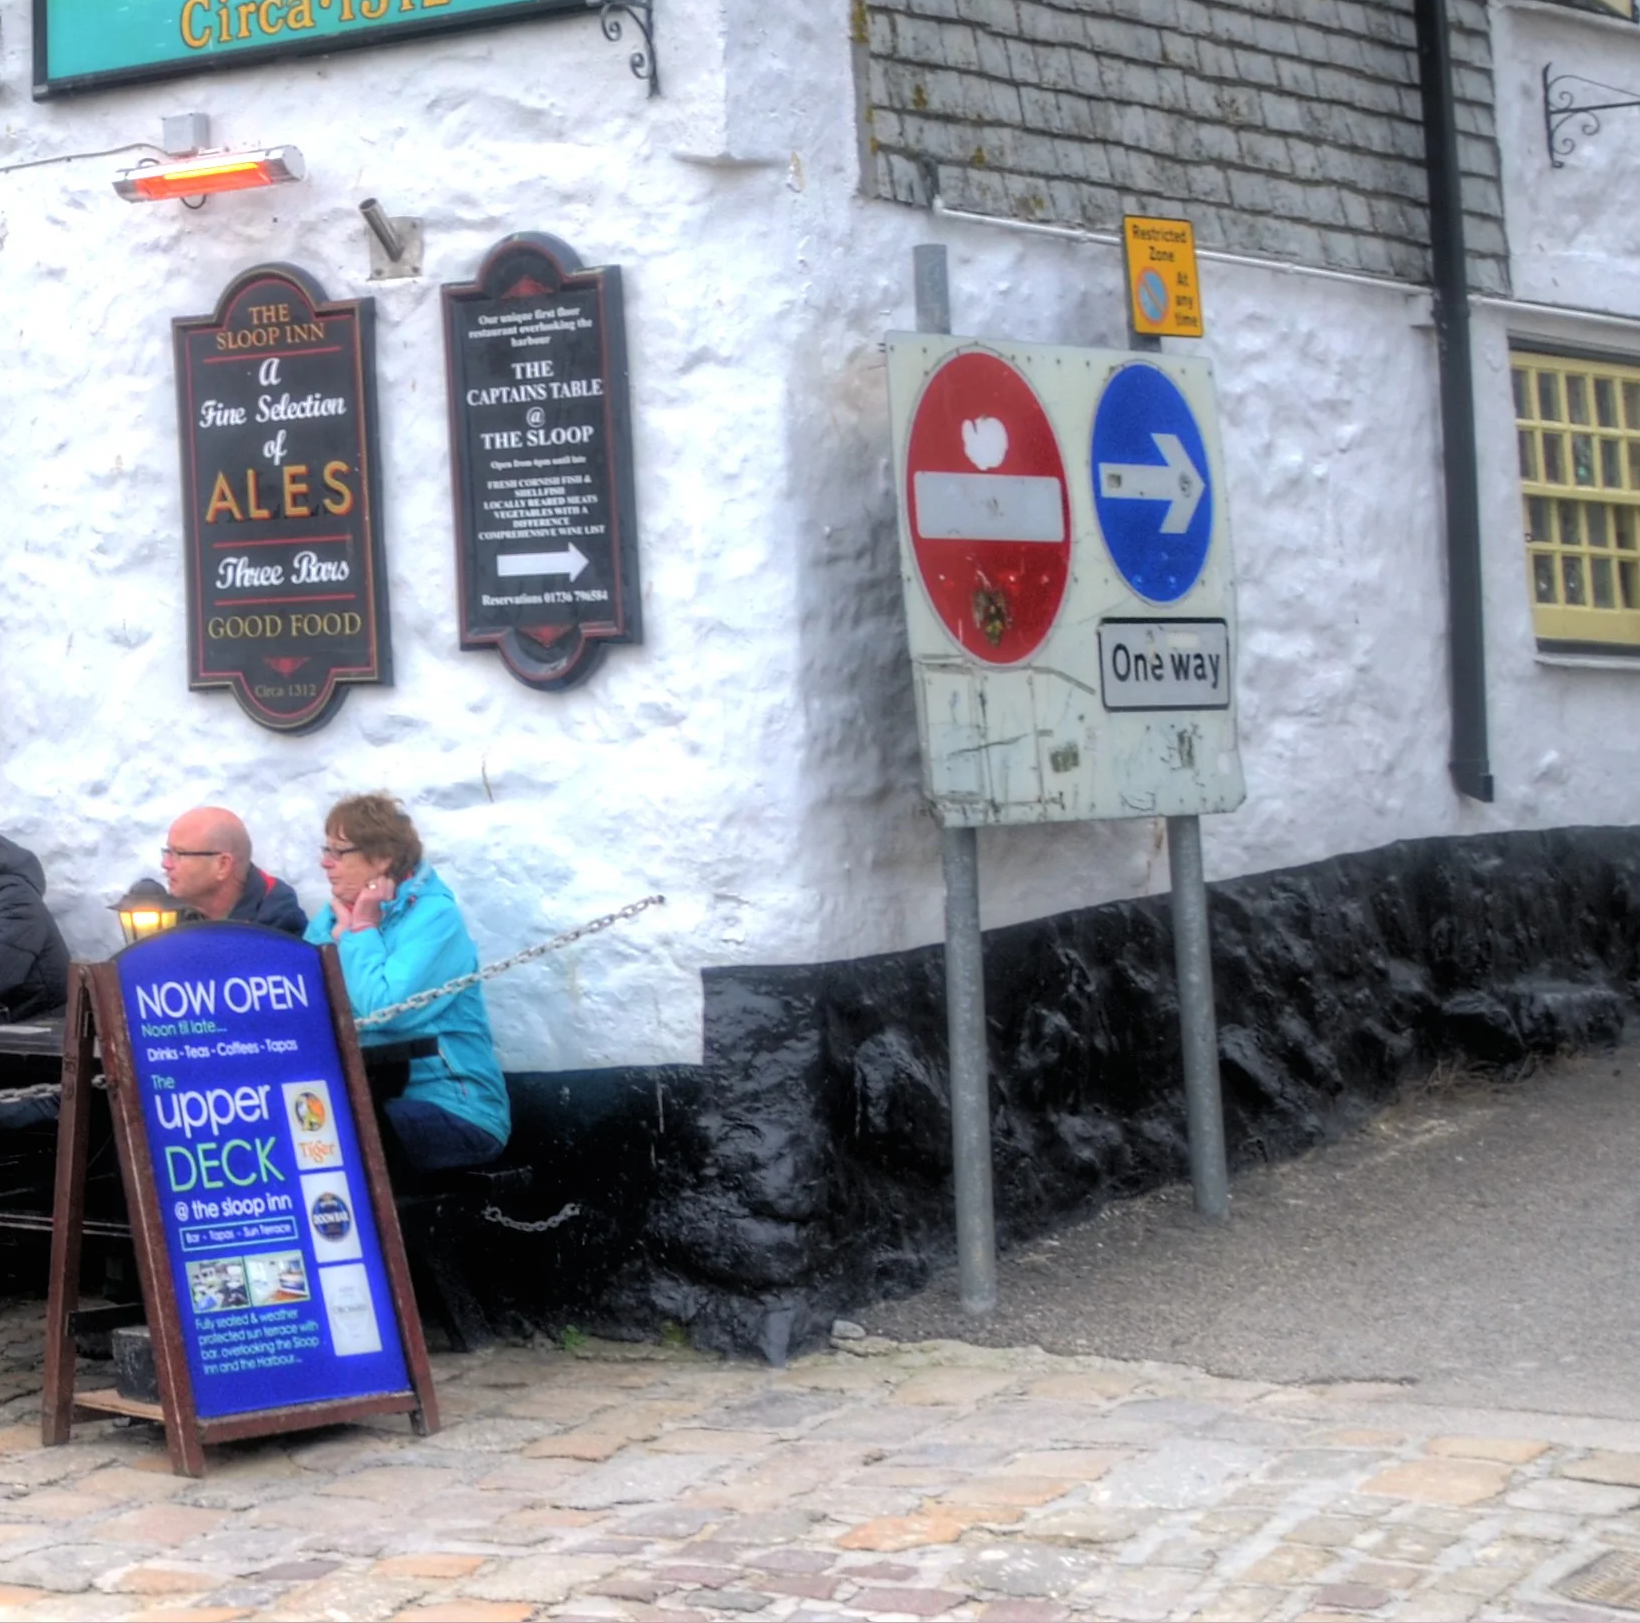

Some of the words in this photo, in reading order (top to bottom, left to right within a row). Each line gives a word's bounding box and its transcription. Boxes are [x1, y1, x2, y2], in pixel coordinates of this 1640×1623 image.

[1133, 224, 1187, 243] Restricted
[1149, 245, 1176, 262] Zone
[1177, 272, 1189, 287] At
[248, 304, 289, 325] THE
[1176, 296, 1193, 310] any
[1175, 312, 1197, 327] time
[216, 326, 280, 350] SLOOP
[285, 322, 325, 343] INN
[511, 360, 554, 380] THE
[467, 383, 547, 406] CAPTAINS
[549, 379, 603, 399] TABLE
[200, 399, 247, 429] Fine
[255, 394, 346, 424] Selection
[526, 406, 545, 428] @
[263, 429, 287, 466] of
[480, 431, 523, 450] THE
[527, 426, 594, 447] SLOOP
[205, 461, 355, 523] ALES
[216, 556, 284, 590] Three
[291, 550, 349, 584] Bars
[208, 613, 282, 640] GOOD
[291, 612, 362, 636] FOOD
[1113, 643, 1164, 682] One
[1170, 653, 1219, 689] way
[136, 980, 215, 1019] NOW
[224, 974, 308, 1013] OPEN
[141, 1022, 177, 1038] Noon
[147, 1047, 179, 1062] Drinks
[185, 1044, 210, 1059] Teas
[217, 1041, 260, 1056] Coffees
[265, 1038, 298, 1053] Tapas
[151, 1074, 175, 1090] The
[155, 1085, 270, 1138] upper
[298, 1140, 334, 1163] Tiger
[165, 1136, 285, 1192] DECK
[175, 1202, 189, 1221] @
[192, 1200, 219, 1219] the
[221, 1197, 265, 1217] sloop
[266, 1192, 292, 1210] inn
